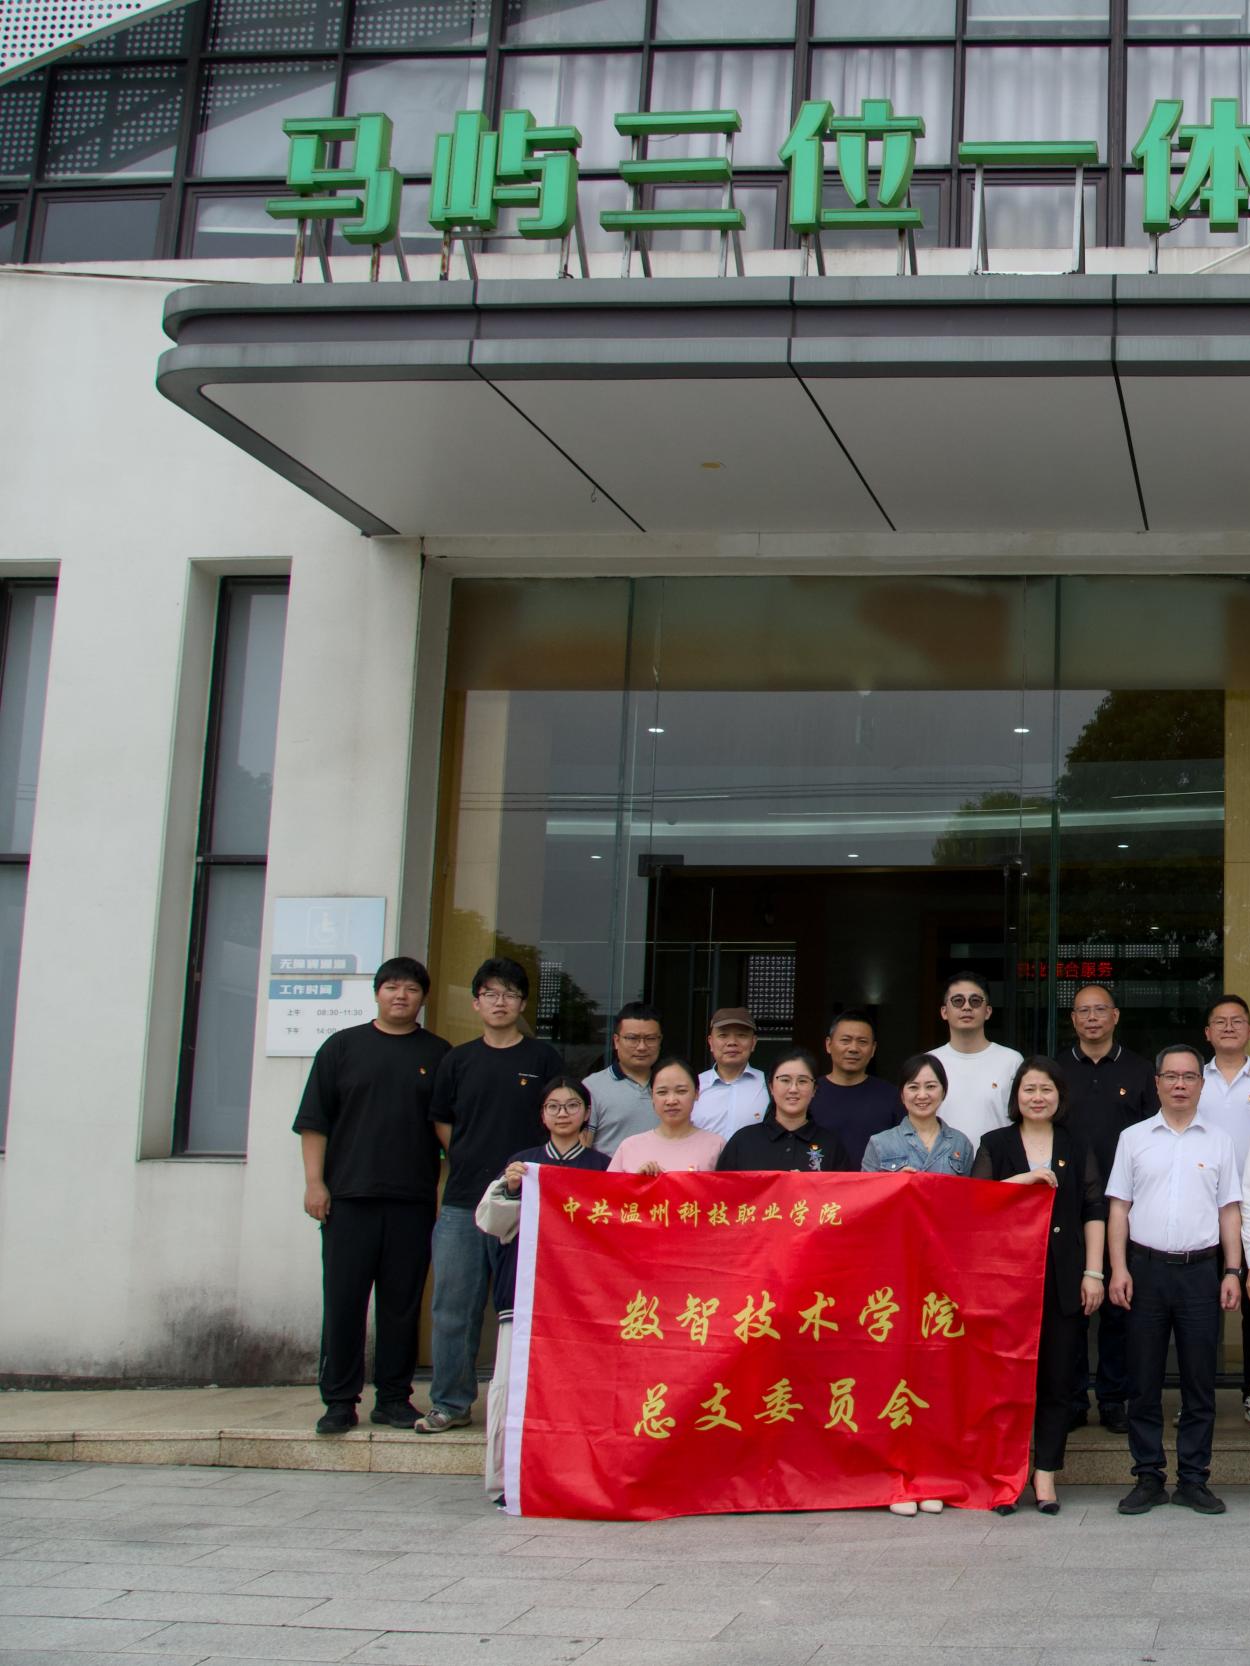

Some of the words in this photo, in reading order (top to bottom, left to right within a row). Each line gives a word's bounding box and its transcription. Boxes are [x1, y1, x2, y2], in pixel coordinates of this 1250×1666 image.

[562, 1196, 843, 1228] 中共温州科技职业学院
[619, 1286, 965, 1345] 数智技术学院
[633, 1376, 930, 1440] 总支委员会
